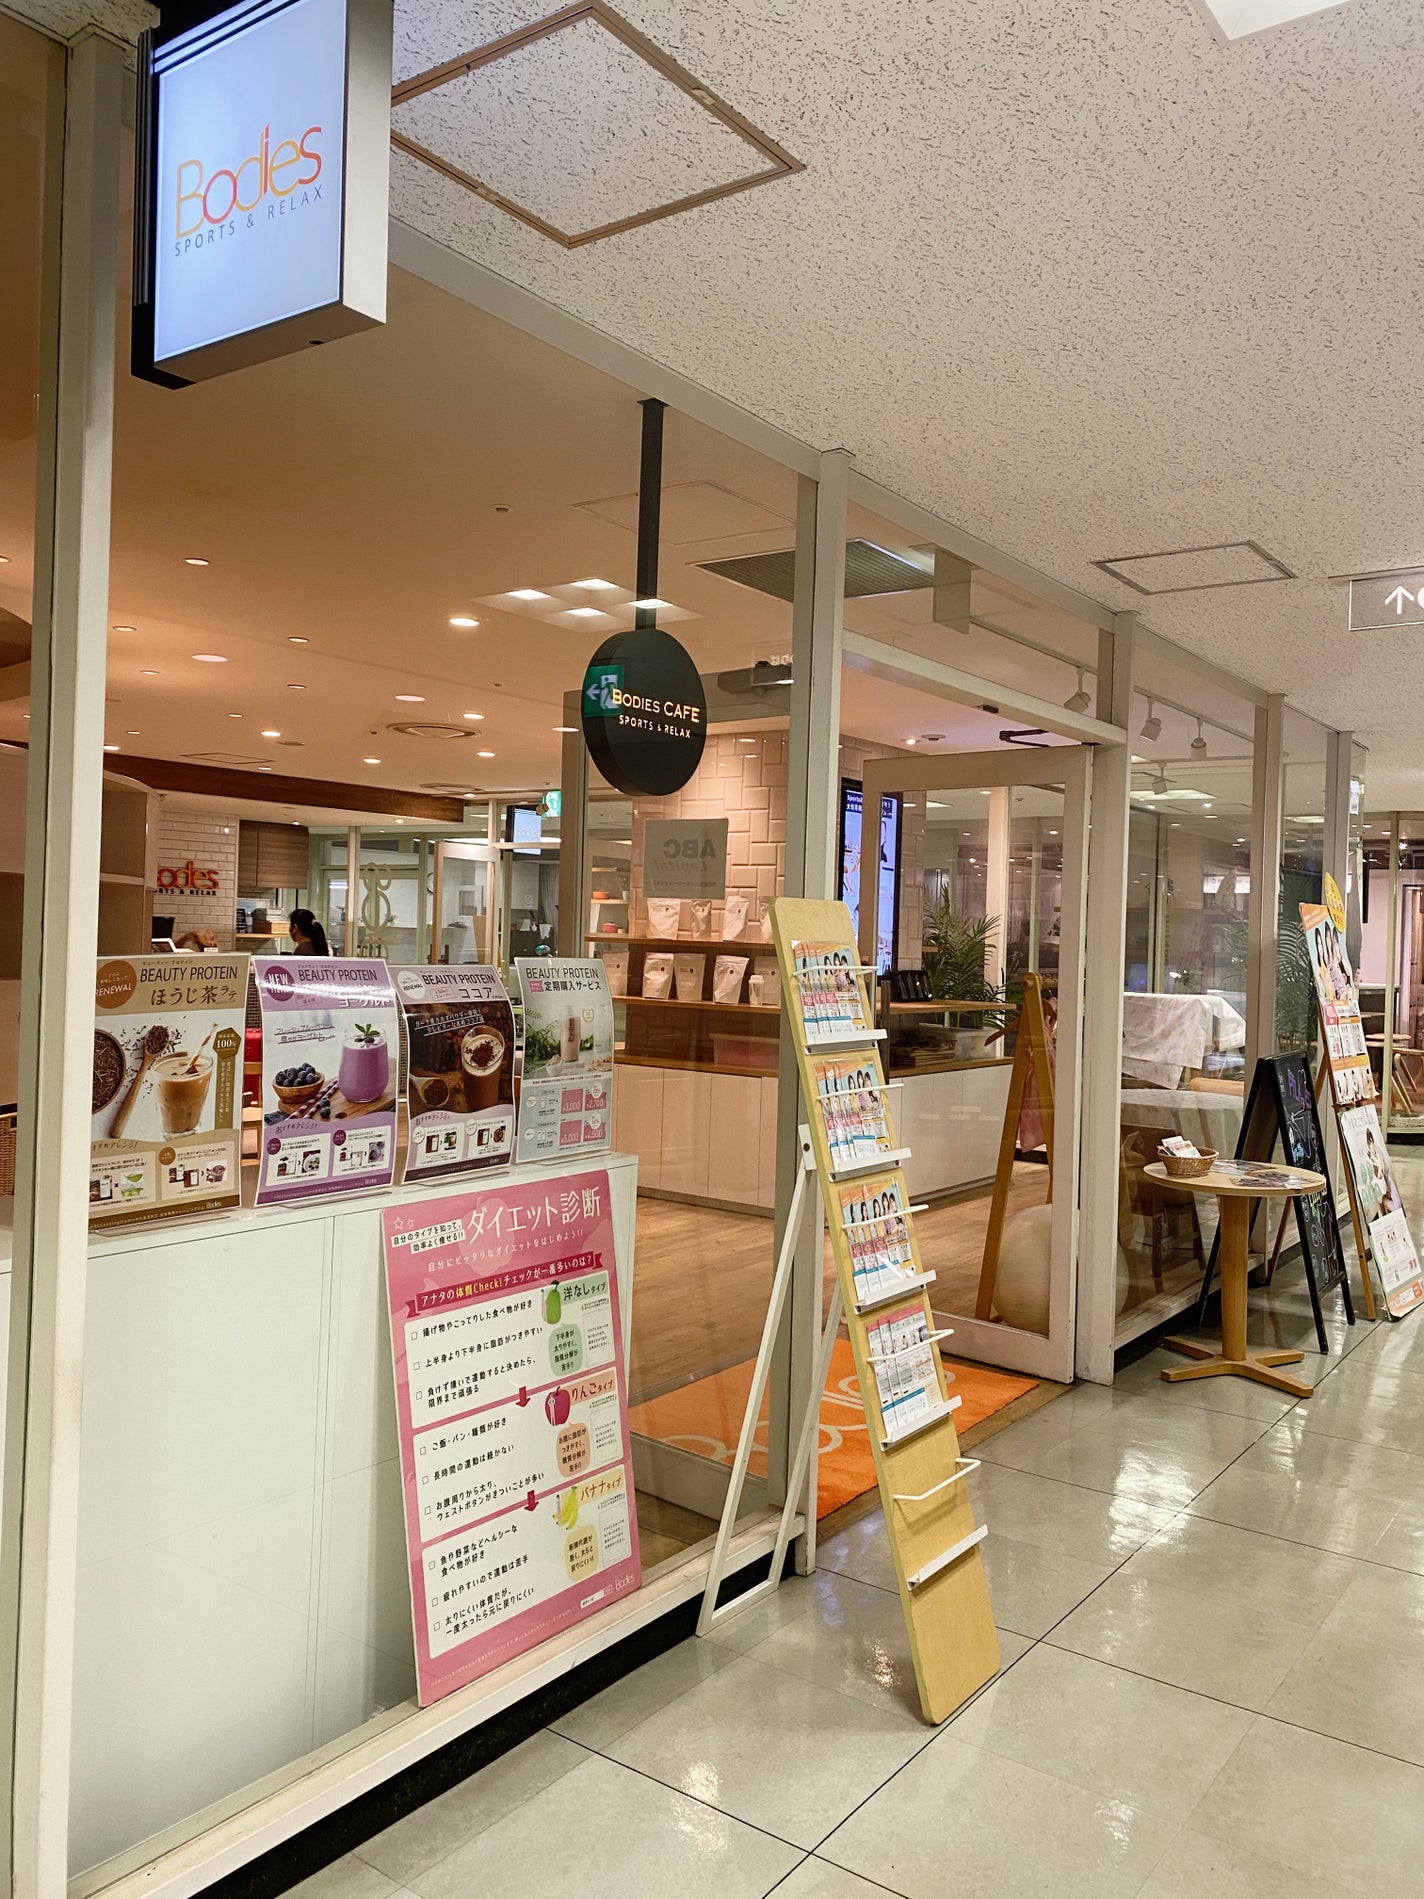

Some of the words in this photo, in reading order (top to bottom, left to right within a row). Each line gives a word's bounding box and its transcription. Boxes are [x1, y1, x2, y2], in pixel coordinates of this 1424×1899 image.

[176, 123, 322, 240] Bodies
[174, 221, 235, 257] SPORTS
[246, 213, 254, 228] &
[267, 185, 322, 220] RELAX
[612, 688, 660, 713] BODIES
[664, 701, 700, 723] CAFE
[619, 714, 653, 731] SPORTS
[657, 723, 662, 732] &
[664, 724, 691, 739] RELAX
[157, 861, 219, 889] odies
[140, 967, 187, 983] BEAUTY
[190, 966, 238, 980] PROTEIN
[298, 969, 336, 981] BEAUTY
[339, 970, 378, 981] PROTEIN
[422, 974, 457, 985] BEAUTY
[460, 973, 496, 983] PROTEIN
[526, 968, 560, 979] BEAUTY
[563, 967, 599, 978] PROTEIN
[458, 987, 492, 999] ココア
[467, 1186, 601, 1244] ダイエット診断
[563, 1282, 607, 1301] 洋なしタイプ
[422, 1300, 533, 1338] 揚げ物やこってりした食べ物が好き
[425, 1327, 543, 1368] 上半身より下半身に脂肪がつきやすい
[428, 1385, 480, 1408] 限界まで頑張る
[571, 1379, 613, 1401] りんごタイプ
[434, 1444, 514, 1481] 長時間の運動は続かない
[580, 1476, 622, 1501] バナナタイプ
[440, 1524, 518, 1564] 魚や野菜などヘルシーな
[441, 1551, 485, 1578] 食べ物が好き
[443, 1554, 529, 1602] 疲れやすいので運動は苦手
[445, 1586, 512, 1626] 太りにくい体質だが、
[446, 1587, 535, 1635] 一度太ったら元に戻りにくい
